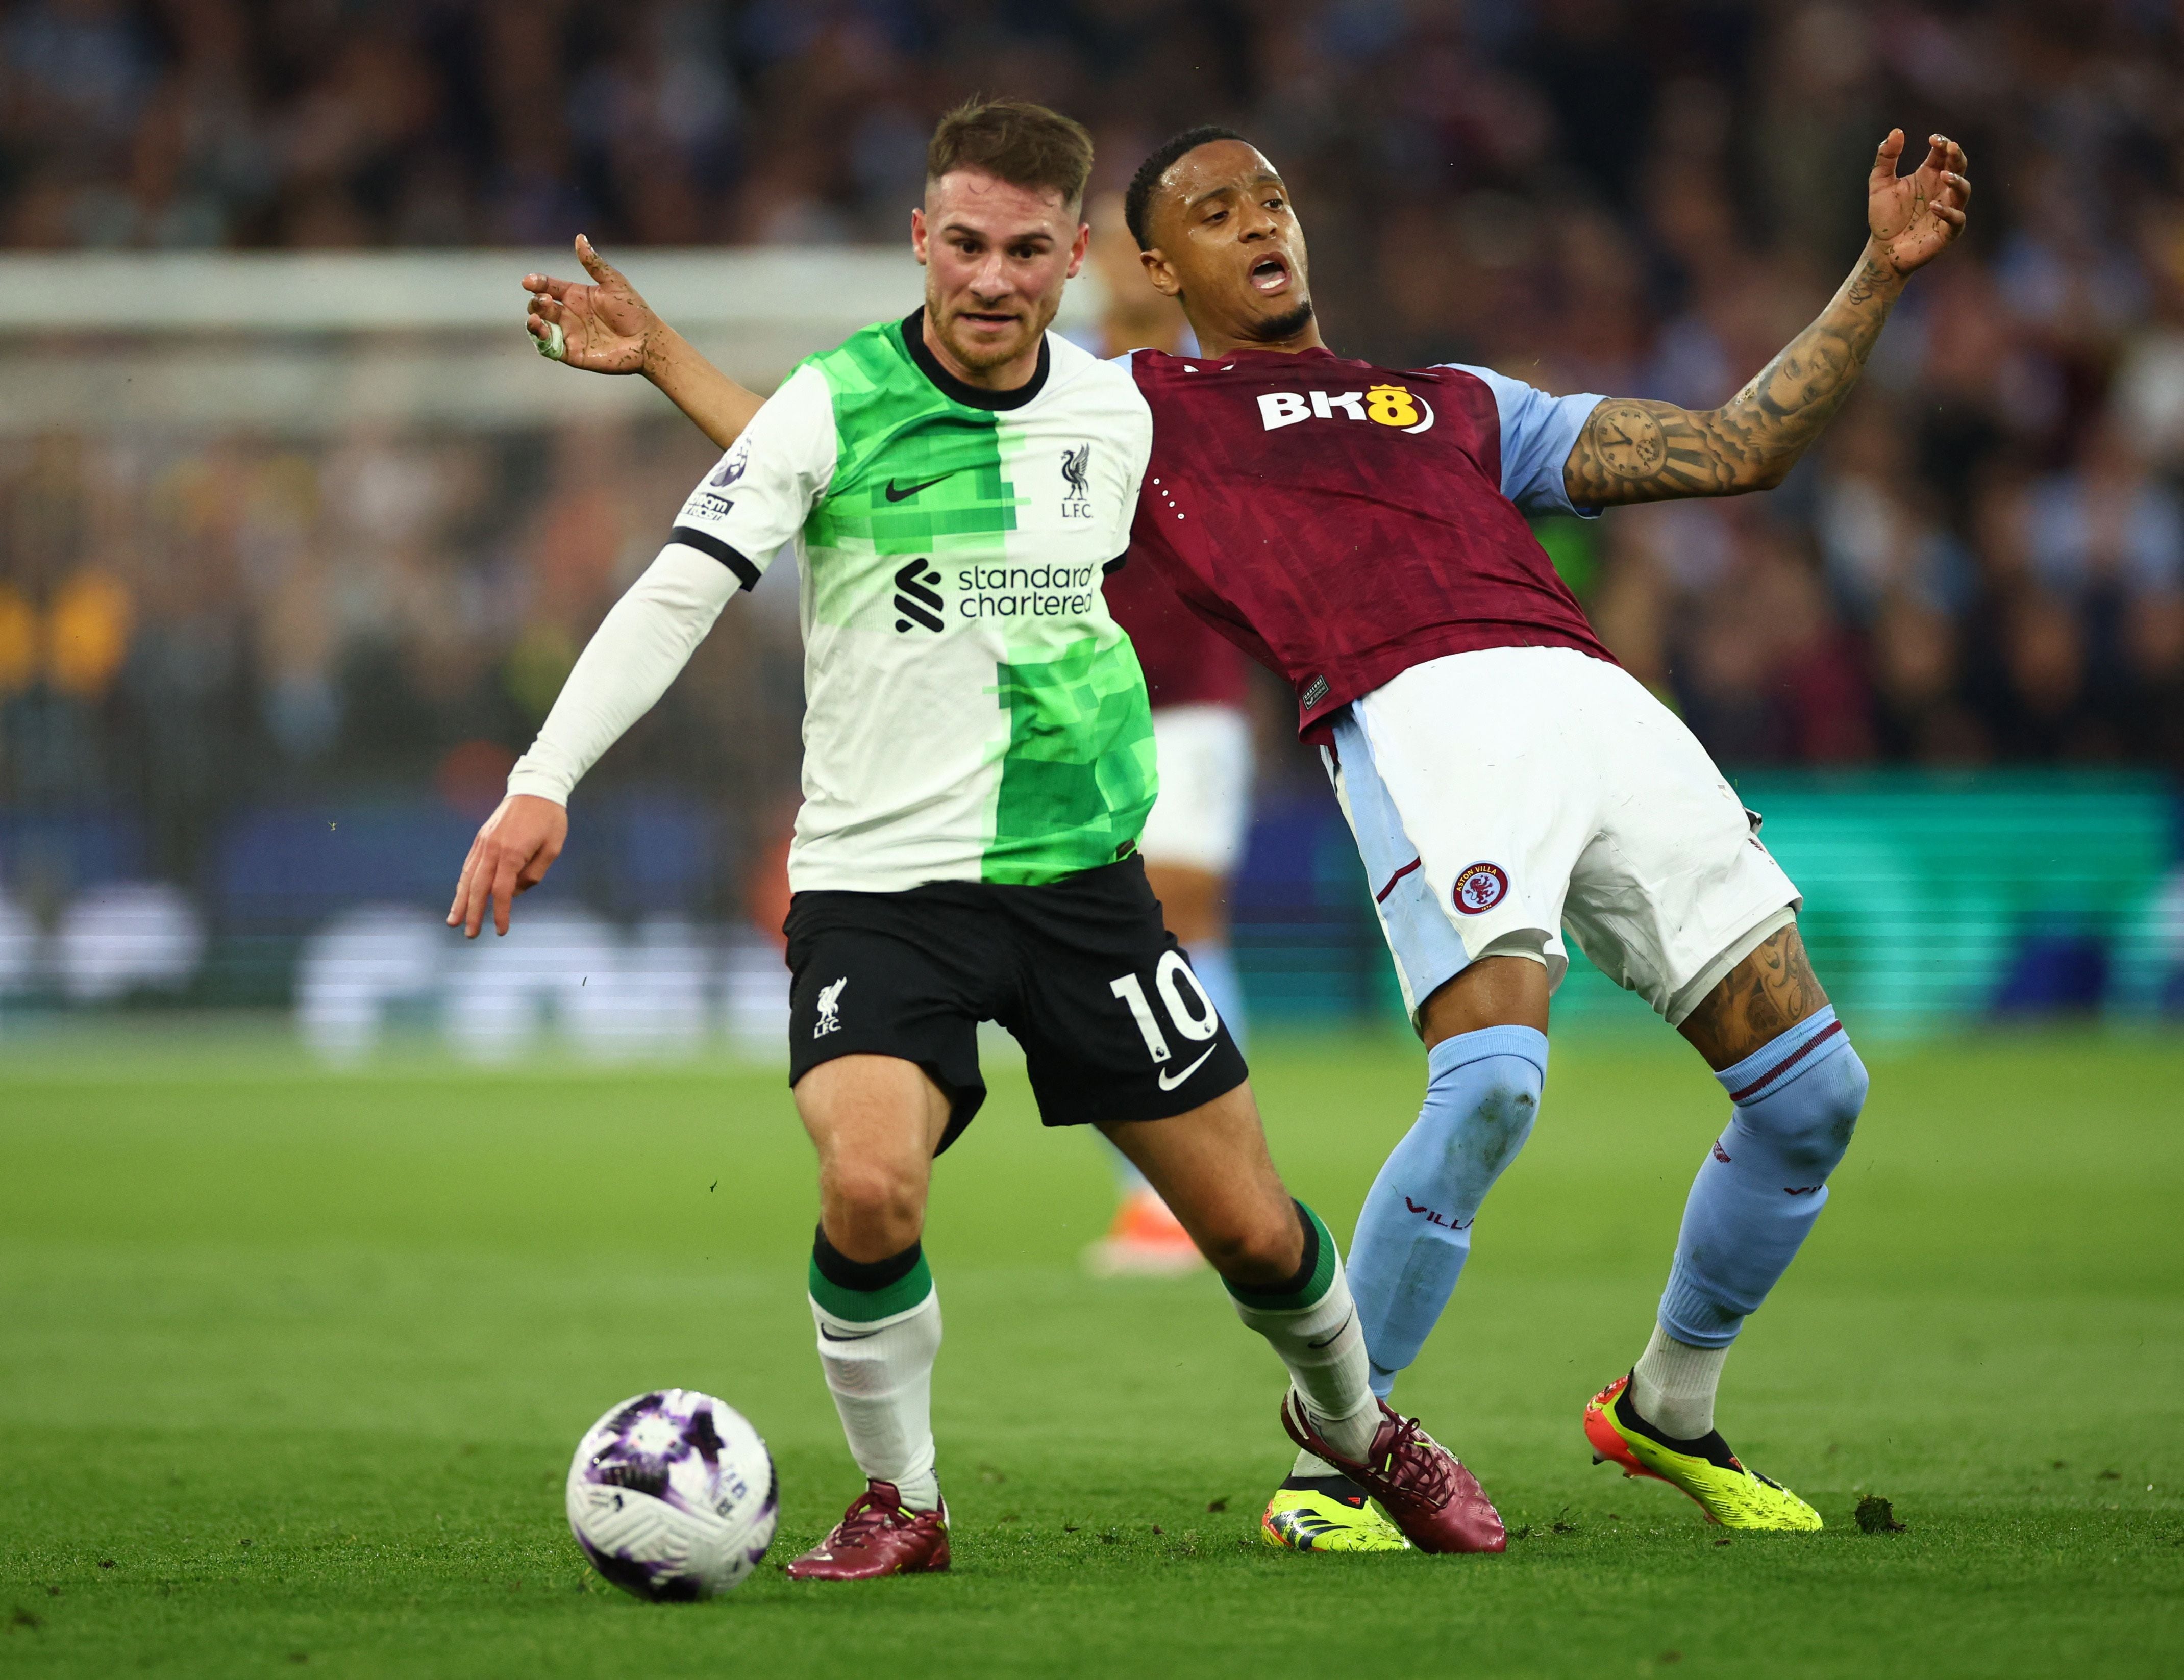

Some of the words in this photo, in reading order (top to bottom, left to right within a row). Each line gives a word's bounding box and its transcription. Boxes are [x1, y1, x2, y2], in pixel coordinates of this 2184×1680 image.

[1256, 385, 1419, 431] BK8
[959, 563, 1093, 590] standard
[960, 588, 1093, 617] chartered
[1456, 869, 1474, 892] ASTON
[1475, 865, 1497, 875] VILLA
[1109, 950, 1219, 1063] 10
